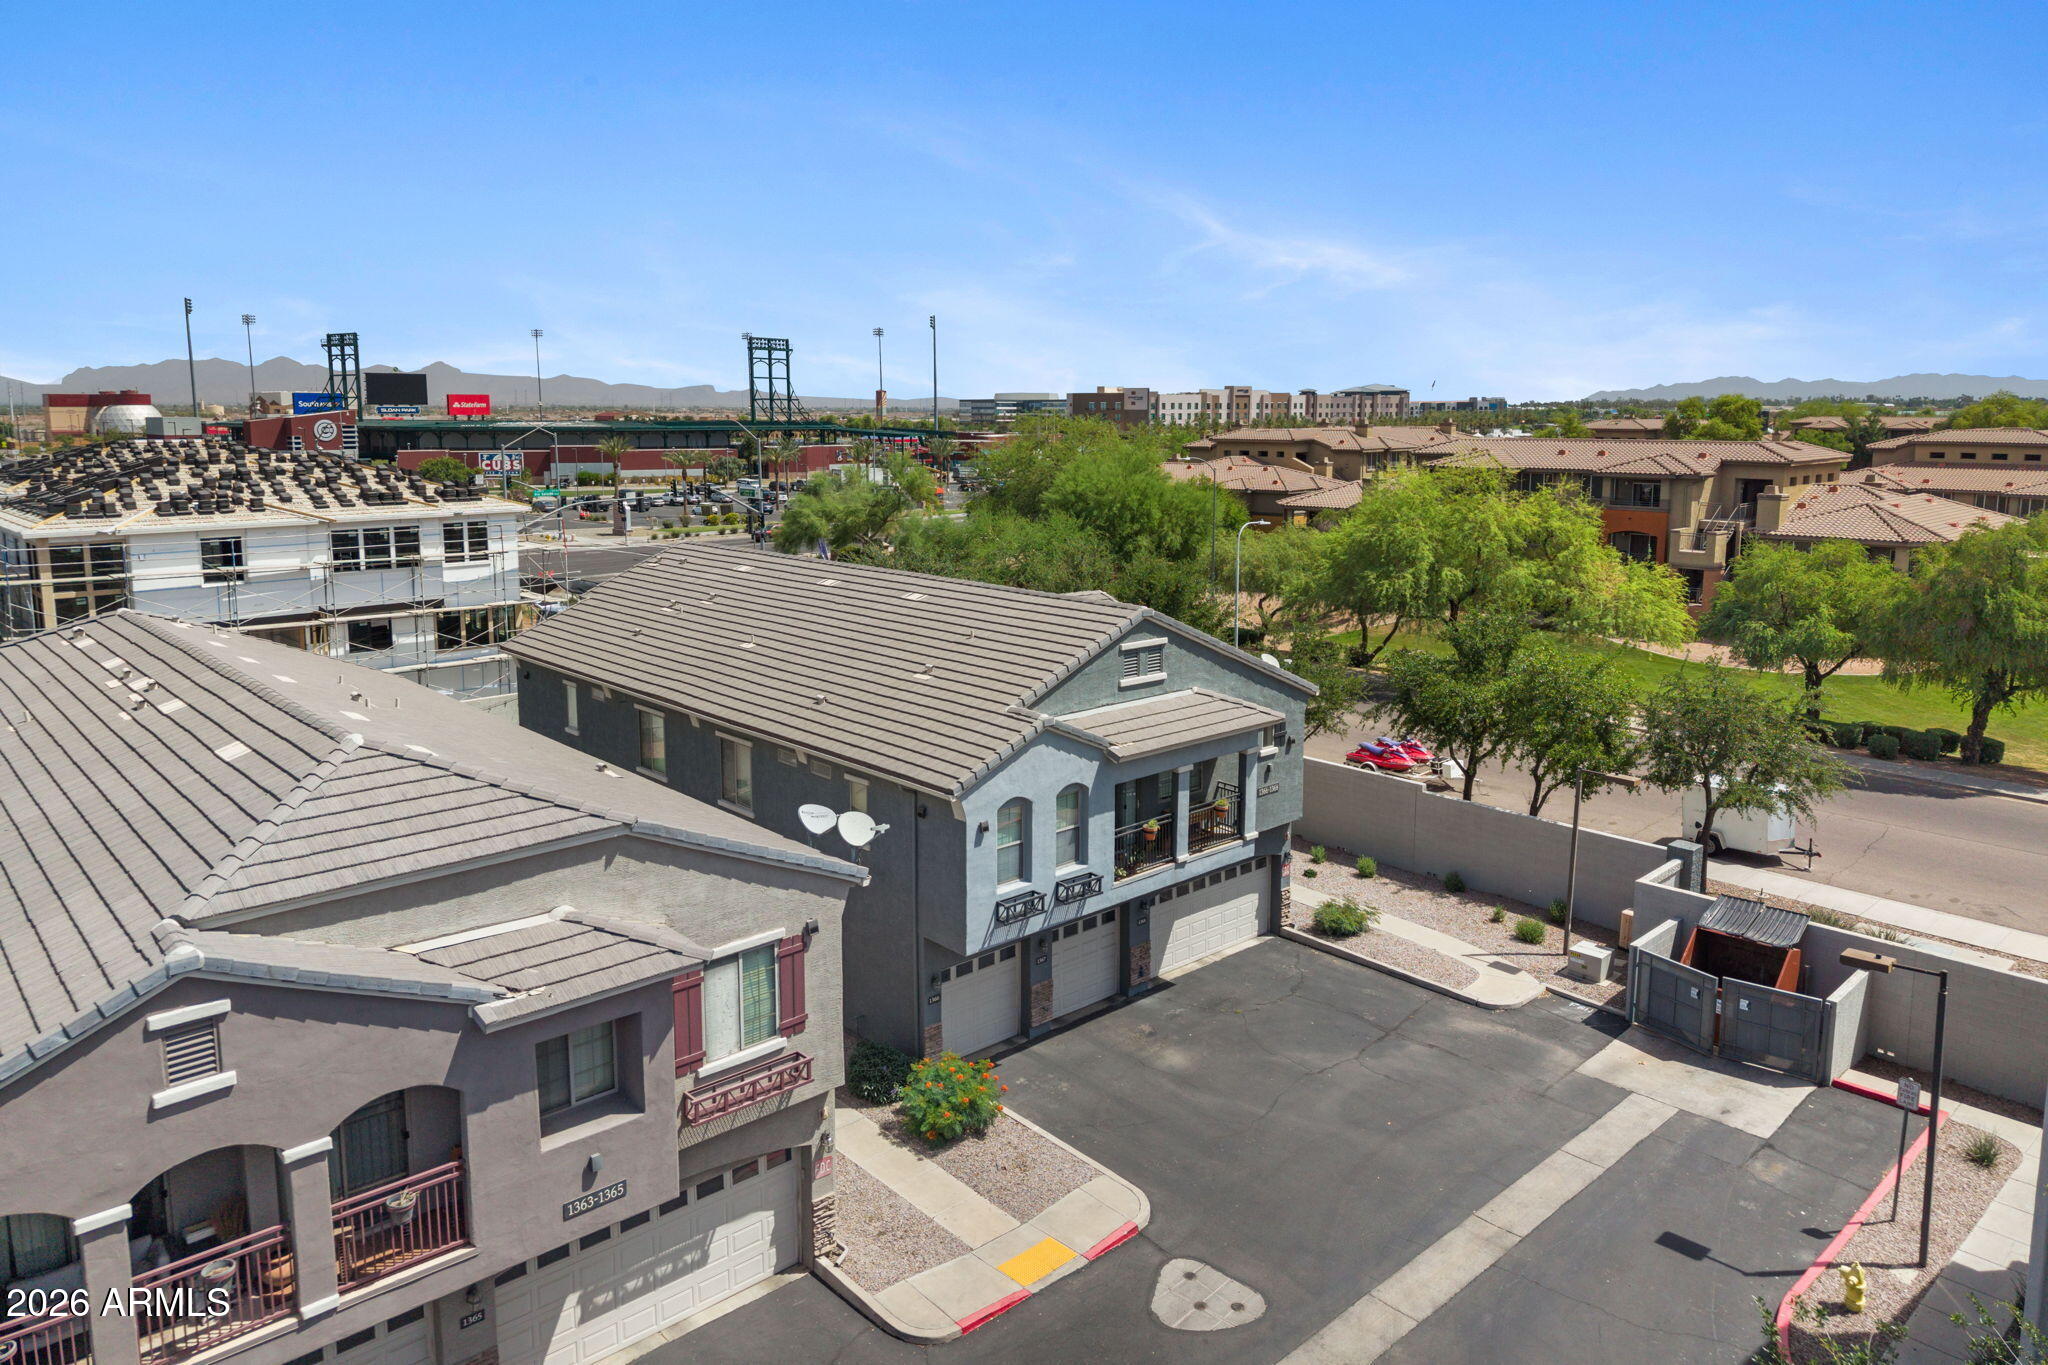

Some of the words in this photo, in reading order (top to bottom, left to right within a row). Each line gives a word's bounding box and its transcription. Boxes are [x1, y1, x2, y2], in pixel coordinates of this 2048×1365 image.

[481, 460, 521, 471] CUBS
[567, 1183, 624, 1216] 1363-1365
[463, 1313, 483, 1327] 1365
